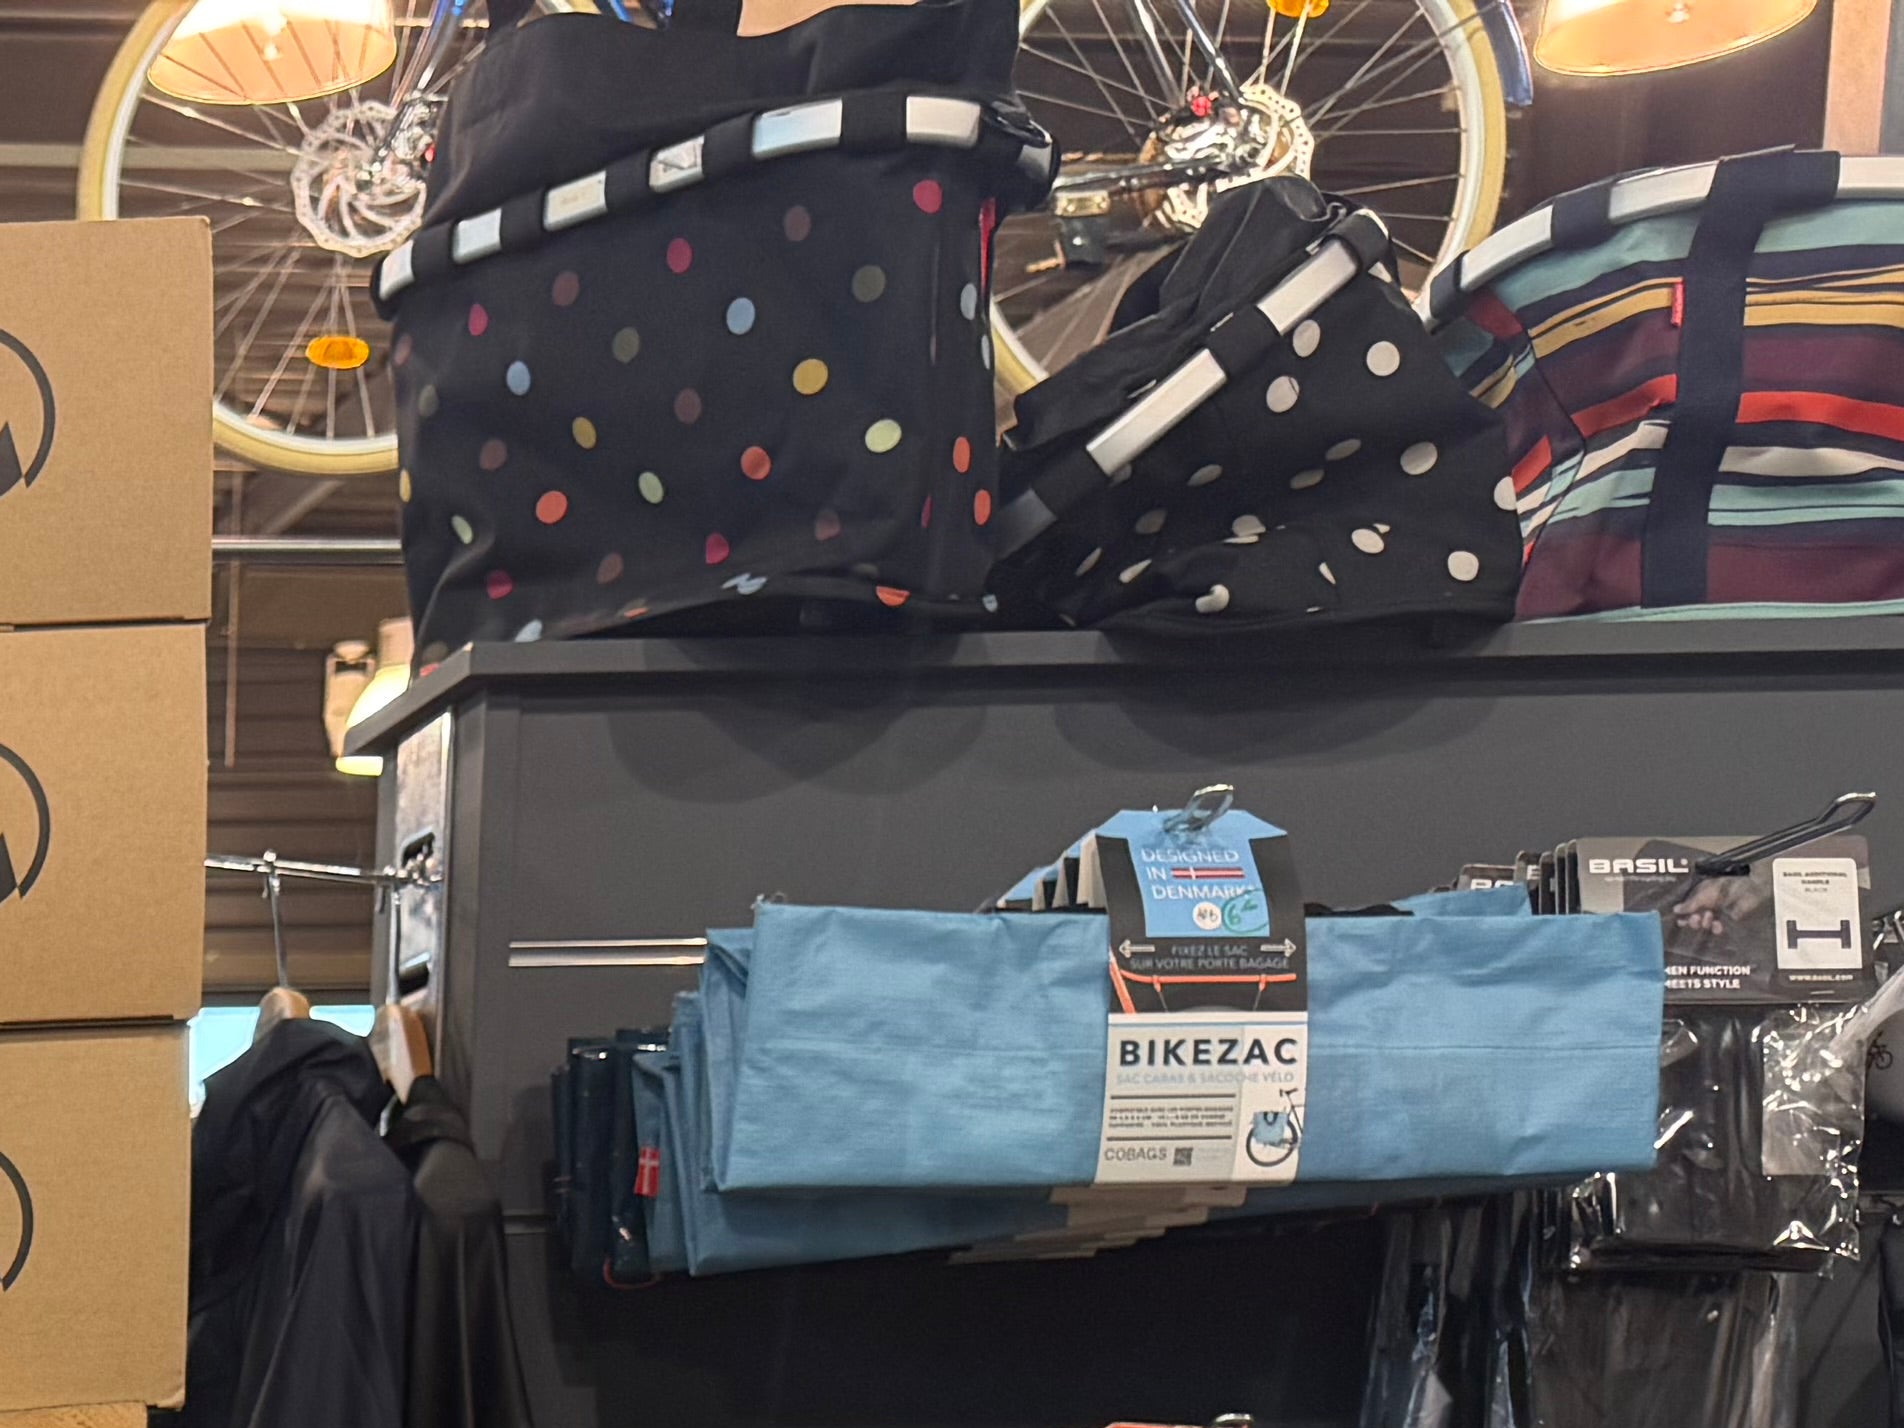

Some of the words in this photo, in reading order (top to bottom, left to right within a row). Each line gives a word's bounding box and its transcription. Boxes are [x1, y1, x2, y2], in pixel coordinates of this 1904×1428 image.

[1142, 849, 1240, 863] DESIGNED
[1588, 858, 1689, 874] BASIL
[1146, 867, 1167, 881] IN
[1129, 957, 1152, 970] SUR
[1156, 957, 1195, 970] VOTRE
[1198, 956, 1235, 969] PORTE
[1239, 956, 1290, 969] BAGAGE
[1690, 965, 1751, 977] FUNCTION
[1703, 979, 1741, 989] STYLE
[1118, 1037, 1299, 1067] BIKEZAC
[1103, 1147, 1169, 1162] COBAGS
